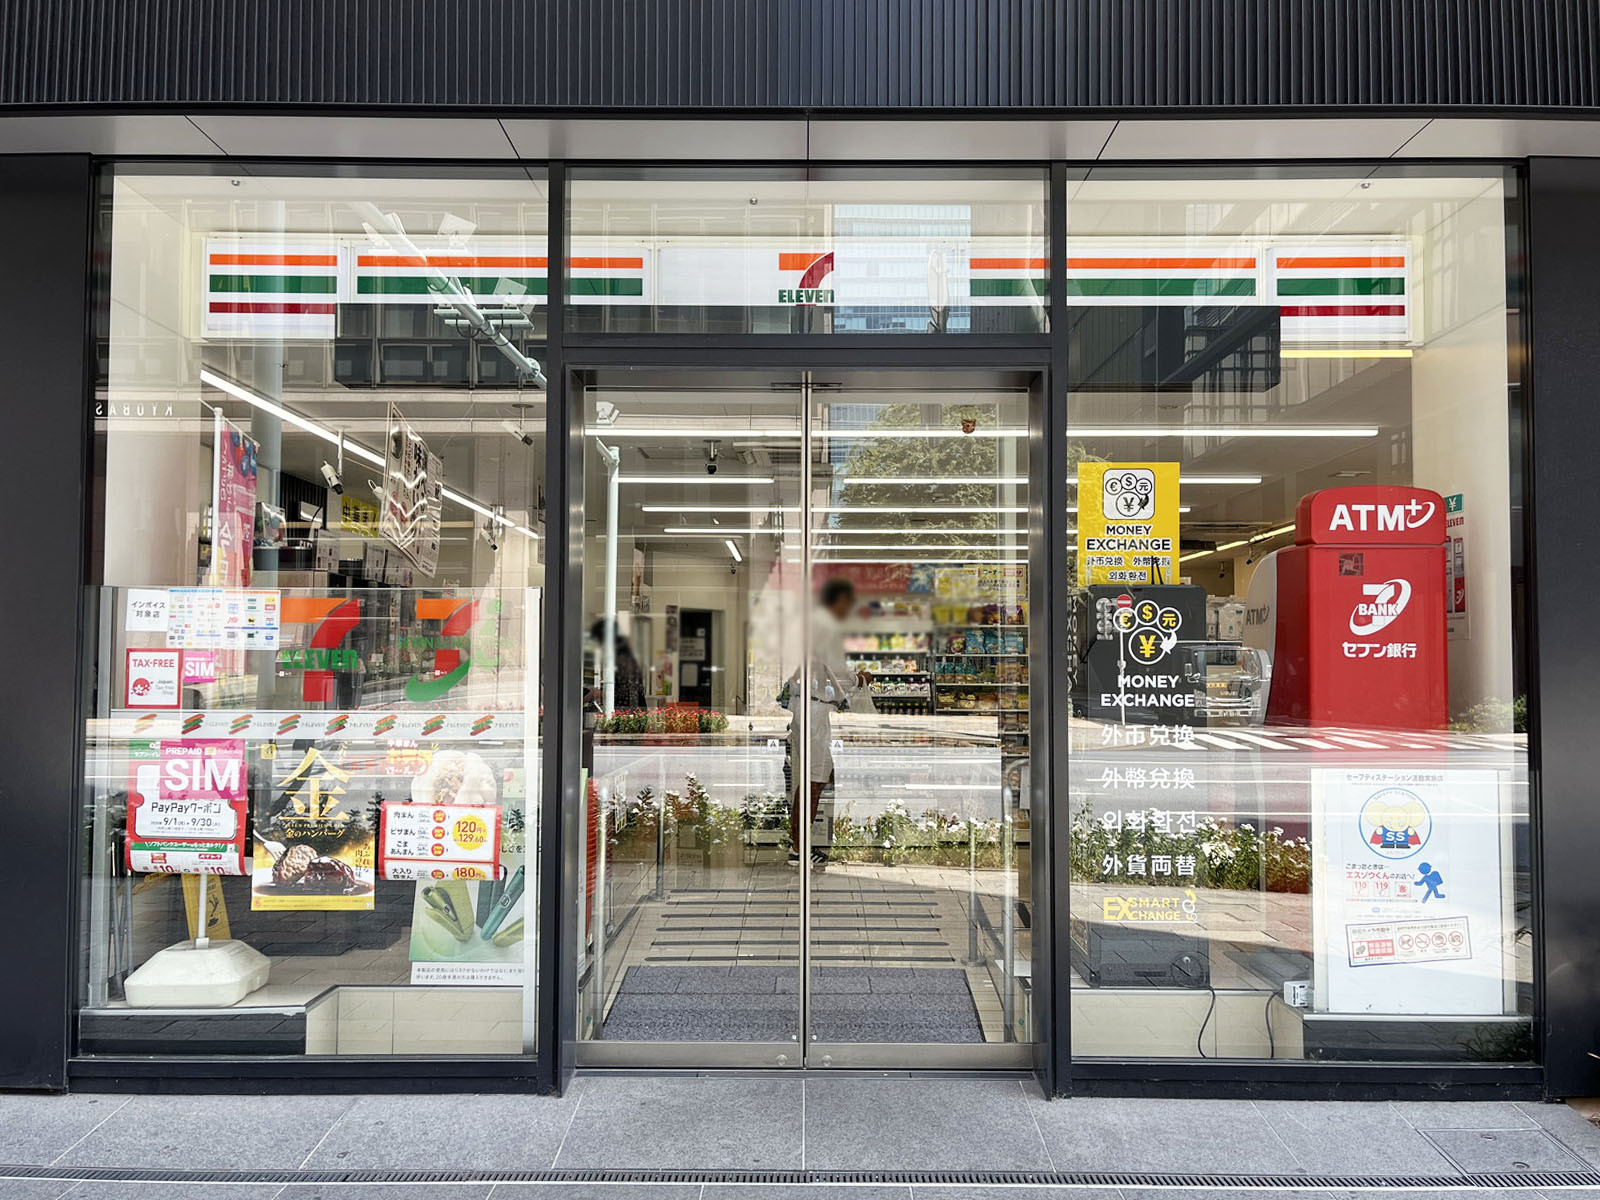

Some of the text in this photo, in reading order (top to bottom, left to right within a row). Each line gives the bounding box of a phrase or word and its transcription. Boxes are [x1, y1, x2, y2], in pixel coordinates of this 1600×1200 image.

[1106, 525, 1152, 535] MONEY
[1086, 539, 1171, 551] EXCHANGE
[1358, 603, 1399, 616] BANK
[132, 659, 175, 668] TAX-FREE
[185, 662, 215, 677] SIM
[1118, 676, 1179, 688] MONEY
[1101, 694, 1195, 707] EXCHANGE
[165, 758, 239, 791] SIM
[276, 747, 351, 821] 金
[285, 828, 345, 839] 金のハンバーグ
[1386, 832, 1405, 842] SS
[1102, 854, 1196, 876] 外貨両替
[455, 867, 475, 878] 180
[1130, 897, 1180, 908] SMART
